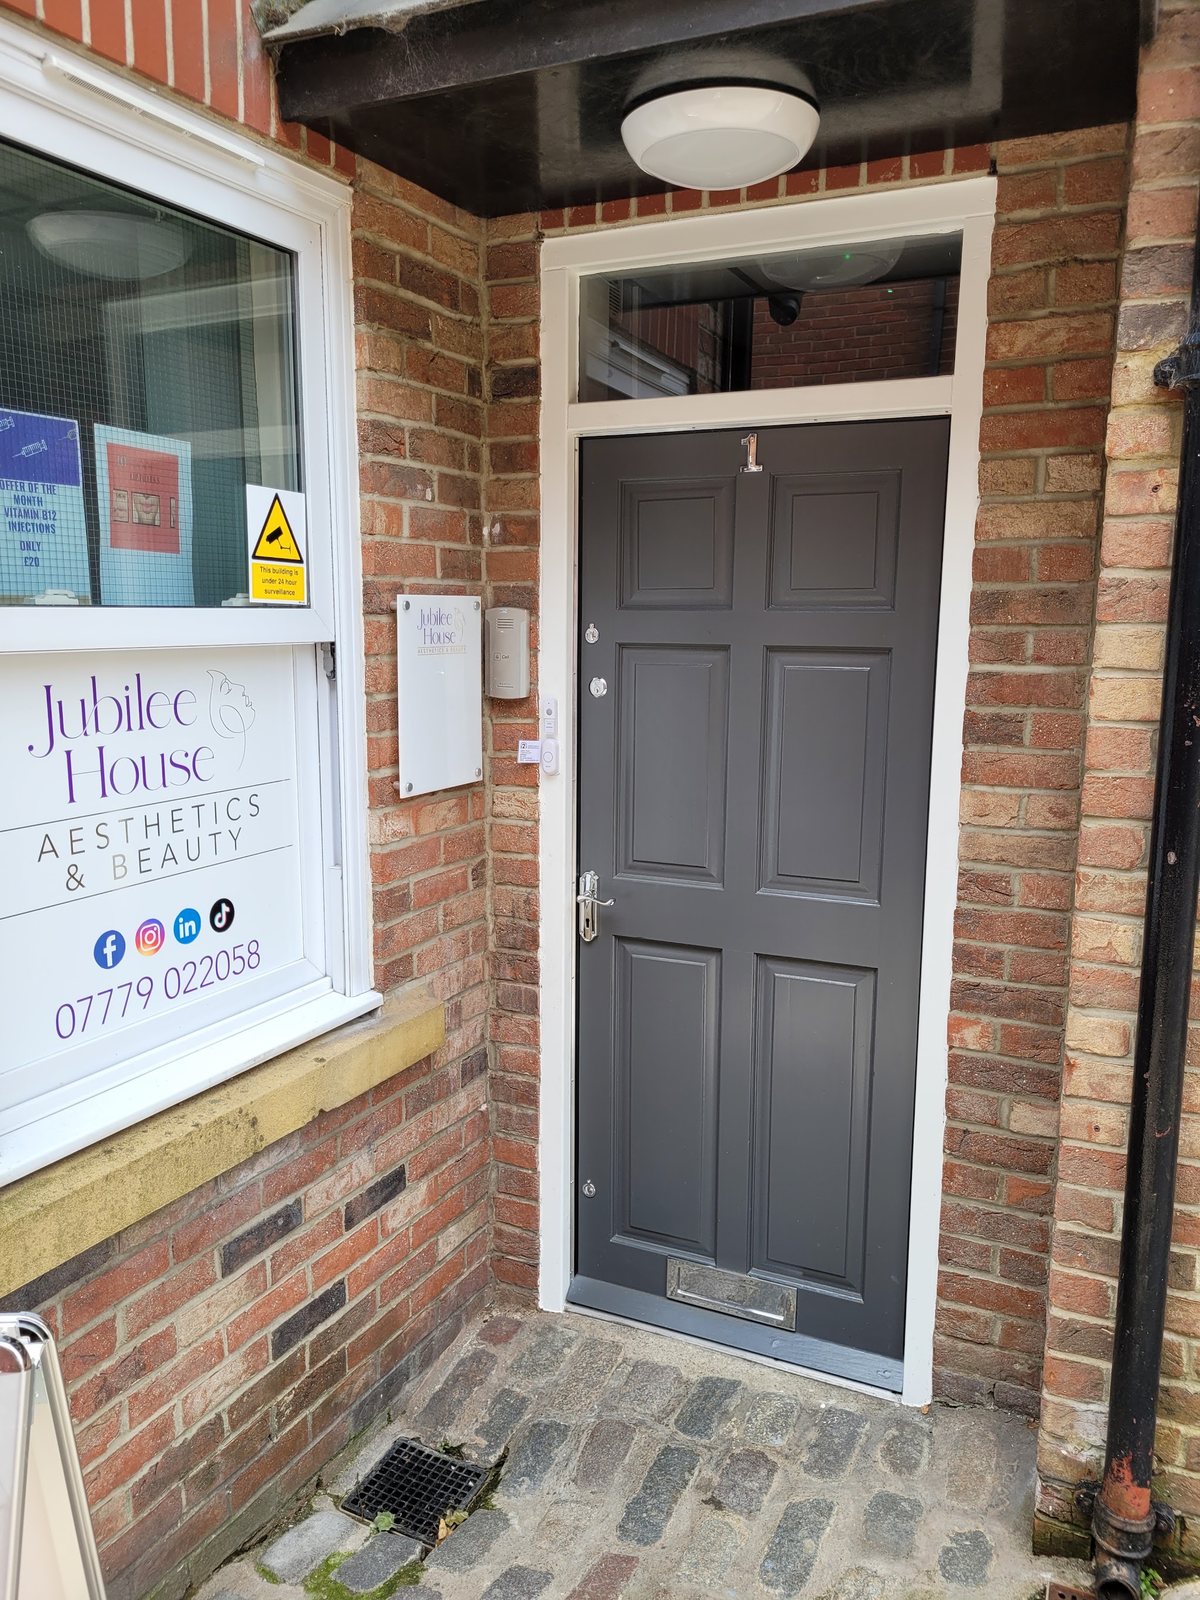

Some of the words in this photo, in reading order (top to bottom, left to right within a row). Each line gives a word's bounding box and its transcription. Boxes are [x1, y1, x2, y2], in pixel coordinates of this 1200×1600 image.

[740, 433, 763, 473] 1
[0, 480, 26, 492] OFFER
[28, 482, 39, 494] OF
[42, 483, 57, 495] THE
[13, 494, 43, 507] MONTH
[4, 507, 39, 520] VITAMIN
[42, 510, 57, 521] B12
[8, 520, 56, 534] INJECTIONS
[20, 540, 41, 552] ONLY
[24, 556, 40, 567] £20
[260, 566, 271, 574] This
[272, 568, 293, 577] building
[264, 588, 296, 596] surveillance
[416, 607, 453, 631] Jubilee
[423, 628, 456, 645] House
[28, 672, 198, 759] Jubilee
[64, 745, 215, 804] House
[37, 793, 260, 863] AESTHETICS
[65, 863, 86, 892] &
[112, 827, 242, 881] BEAUTY
[55, 976, 154, 1040] 07779
[164, 939, 261, 1000] 022058
